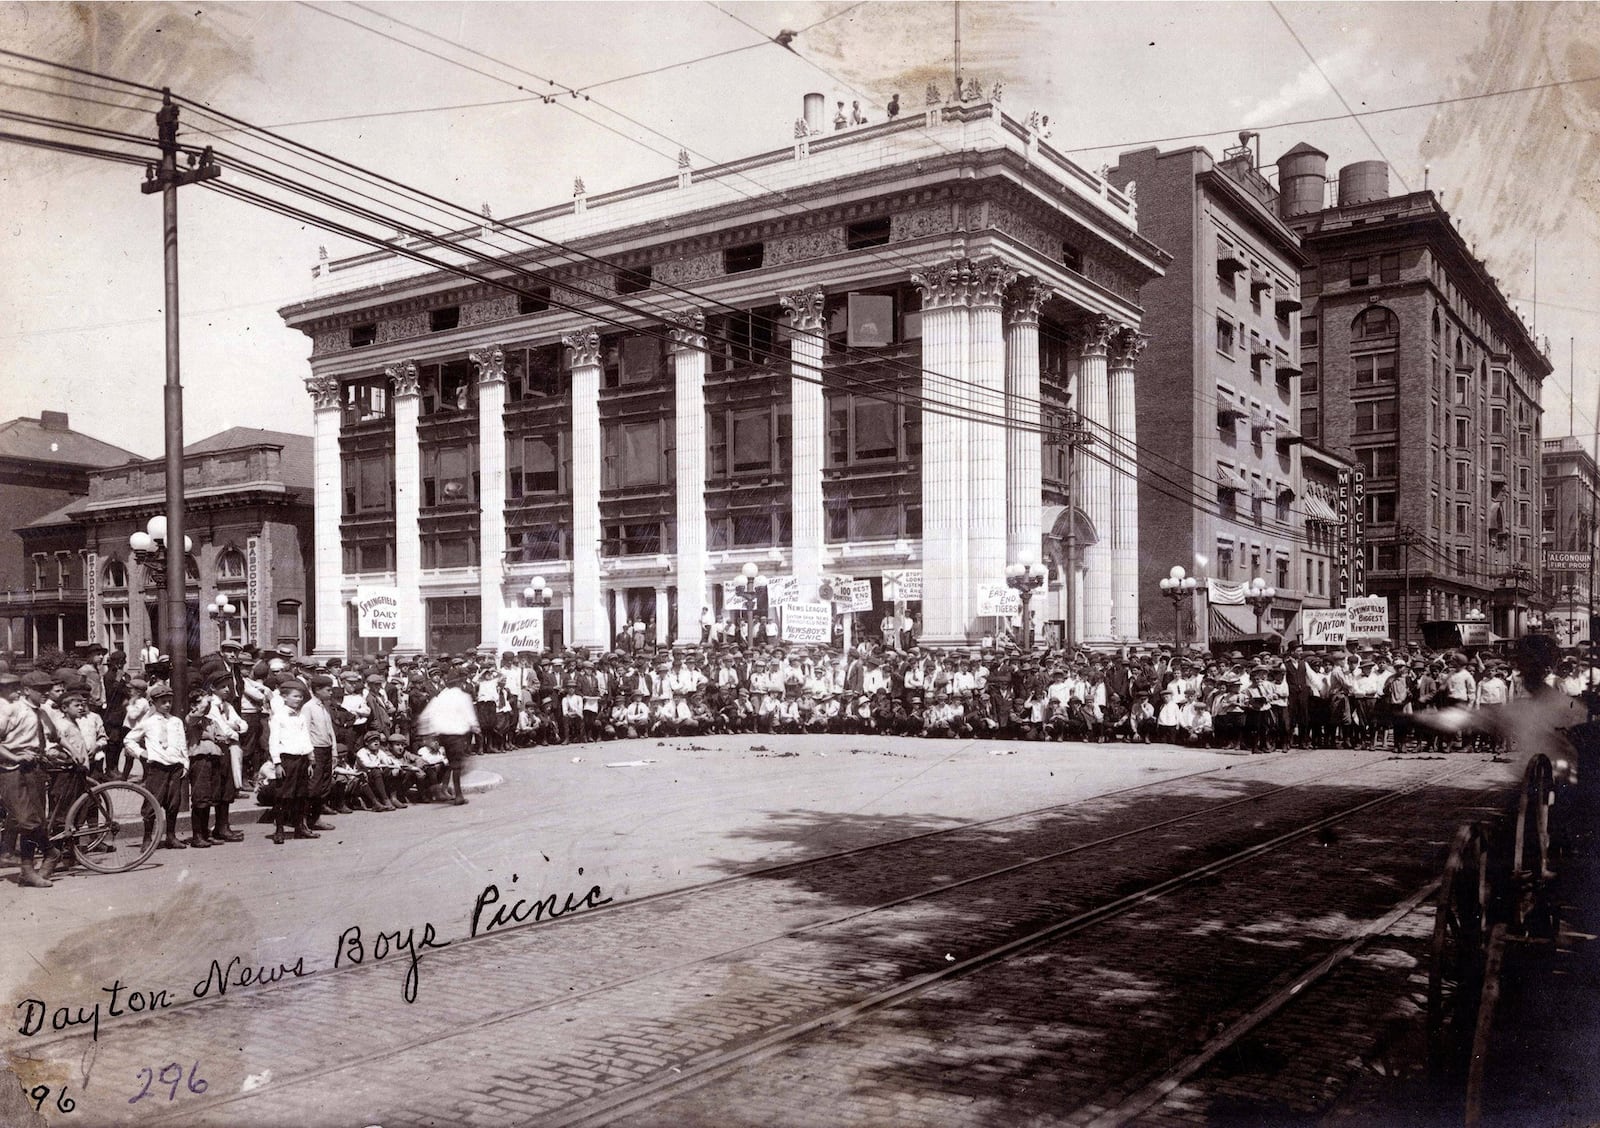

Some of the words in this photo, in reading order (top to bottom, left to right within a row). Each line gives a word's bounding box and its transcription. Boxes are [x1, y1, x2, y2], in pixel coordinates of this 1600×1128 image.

[1354, 472, 1364, 505] DRY
[1339, 473, 1348, 606] MENDENHALL
[1355, 512, 1364, 598] CLEANIN
[1550, 554, 1591, 562] ALGONQUIN
[840, 587, 851, 596] 100
[988, 590, 1007, 599] EAST
[1000, 595, 1017, 604] END
[359, 596, 397, 618] SPRINGFIELD
[995, 604, 1018, 612] TIGERS
[373, 609, 397, 619] DAILY
[1358, 615, 1383, 623] BIGGEST
[371, 619, 396, 630] NEWS
[1316, 619, 1346, 636] DAYTON
[1350, 622, 1385, 633] NEWSPAPER
[512, 635, 540, 649] Outing
[788, 633, 822, 641] PICNIC
[1325, 633, 1345, 642] VIEW
[193, 959, 316, 998] News
[335, 926, 450, 1003] Boys
[470, 867, 613, 937] Picnic
[128, 1060, 209, 1104] 296
[23, 1085, 76, 1113] 96
